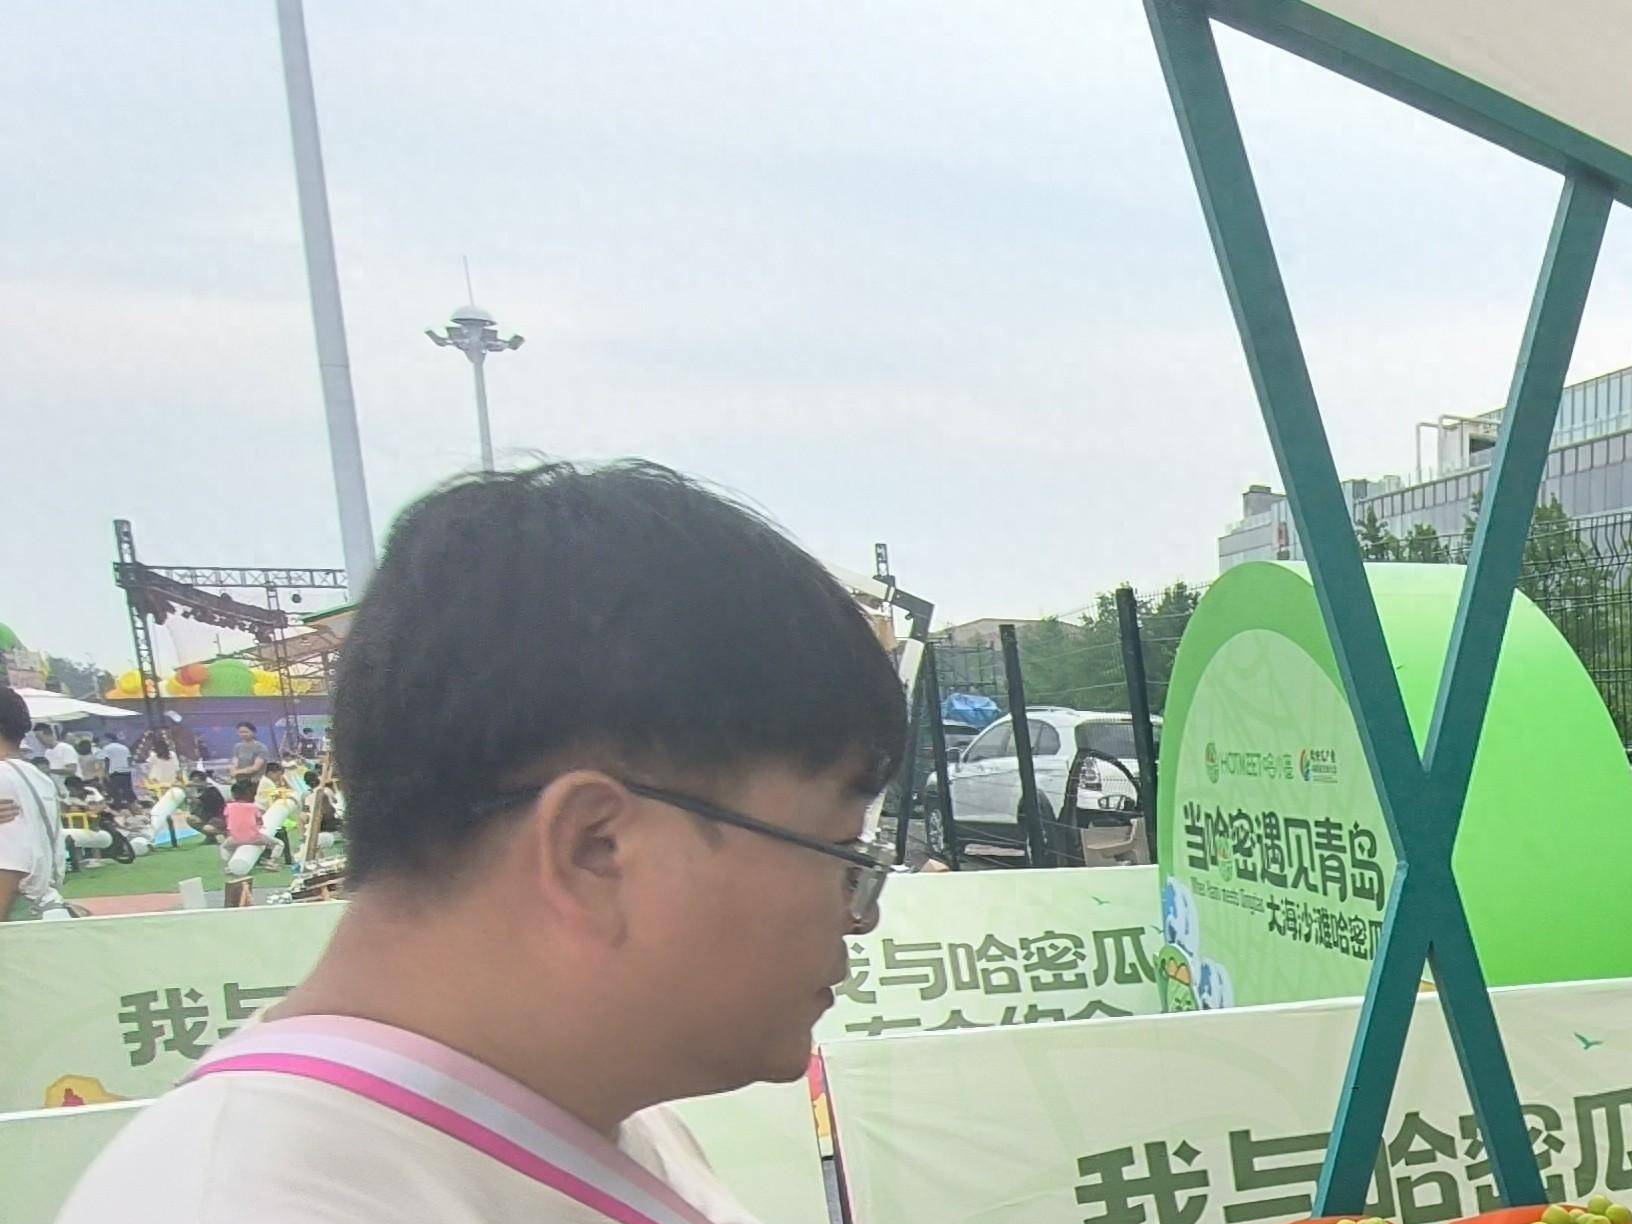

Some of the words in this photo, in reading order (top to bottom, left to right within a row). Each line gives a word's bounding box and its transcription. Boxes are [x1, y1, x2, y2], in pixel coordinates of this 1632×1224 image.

[1183, 801, 1385, 912] 当哈密遇见青岛
